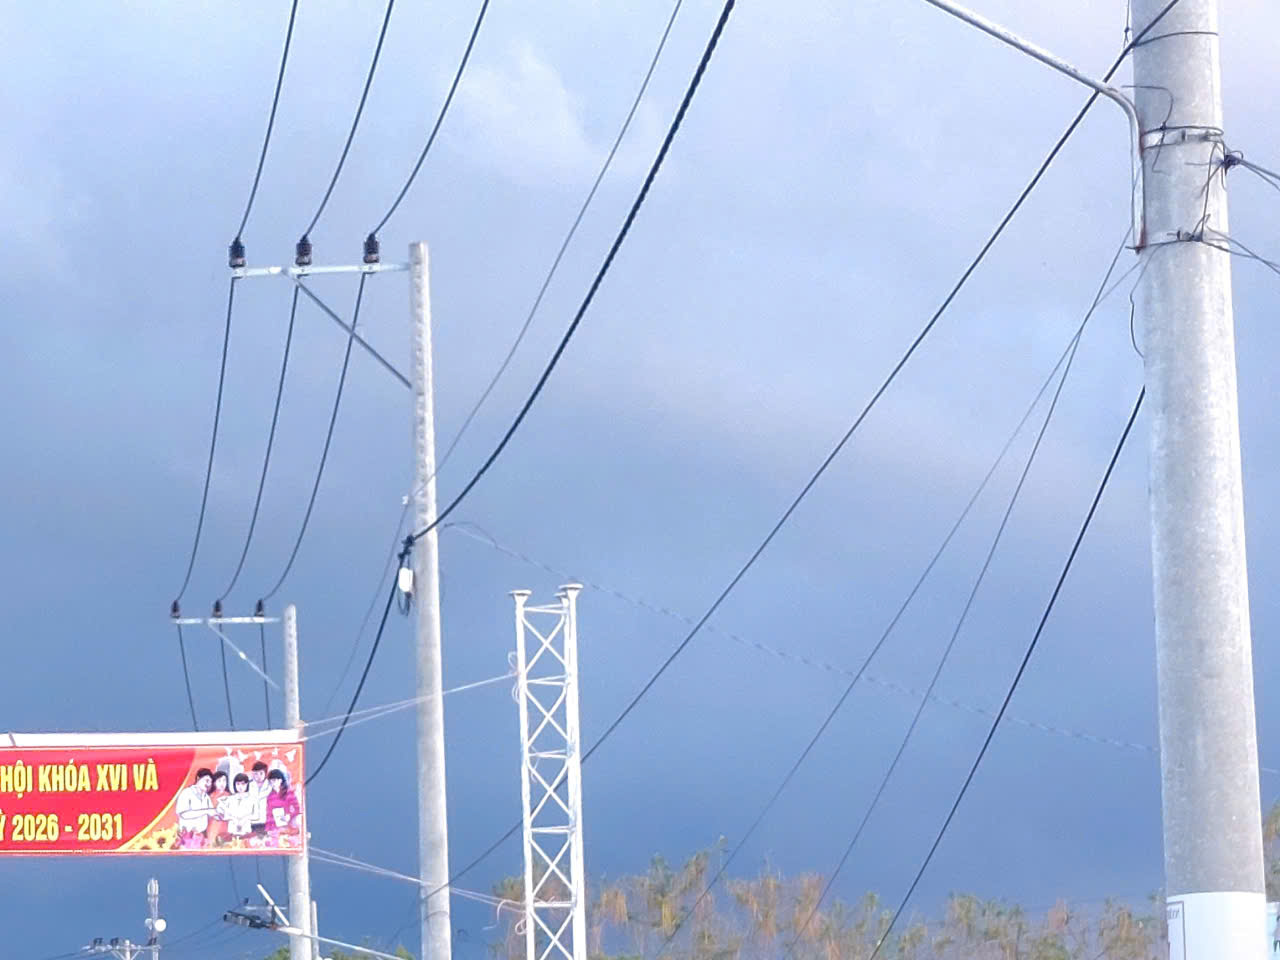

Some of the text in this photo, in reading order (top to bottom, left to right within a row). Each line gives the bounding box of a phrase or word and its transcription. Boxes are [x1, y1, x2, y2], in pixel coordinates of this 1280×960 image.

[0, 759, 33, 799] HỘI
[39, 757, 92, 793] KHÓA
[96, 764, 128, 792] XVI
[132, 757, 159, 792] VÀ
[11, 813, 60, 842] 2026
[77, 812, 123, 841] 2031
